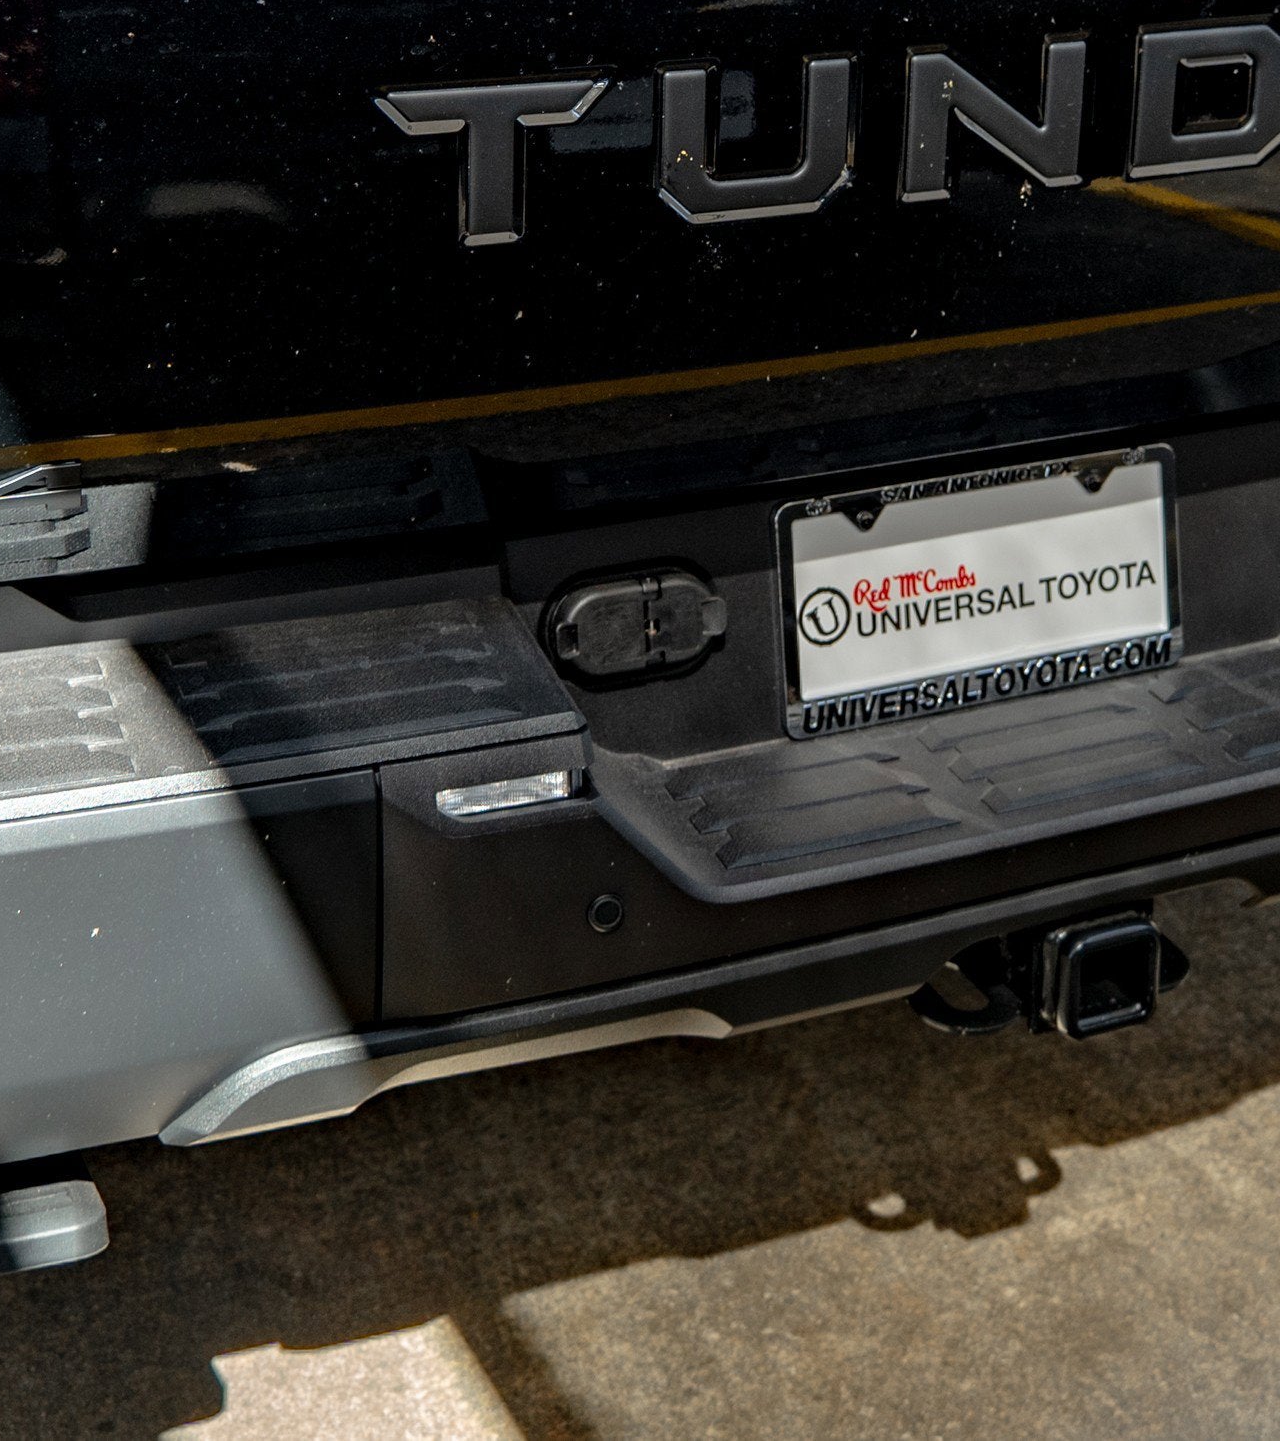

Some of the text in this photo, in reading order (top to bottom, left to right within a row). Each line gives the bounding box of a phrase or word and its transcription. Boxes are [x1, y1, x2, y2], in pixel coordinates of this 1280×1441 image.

[880, 482, 927, 505] SAN
[853, 564, 977, 613] Red McCombs
[855, 559, 1157, 638] UNIVERSAL TOYOTA
[801, 633, 1173, 735] UNIVERSALTOYOTA.COM
